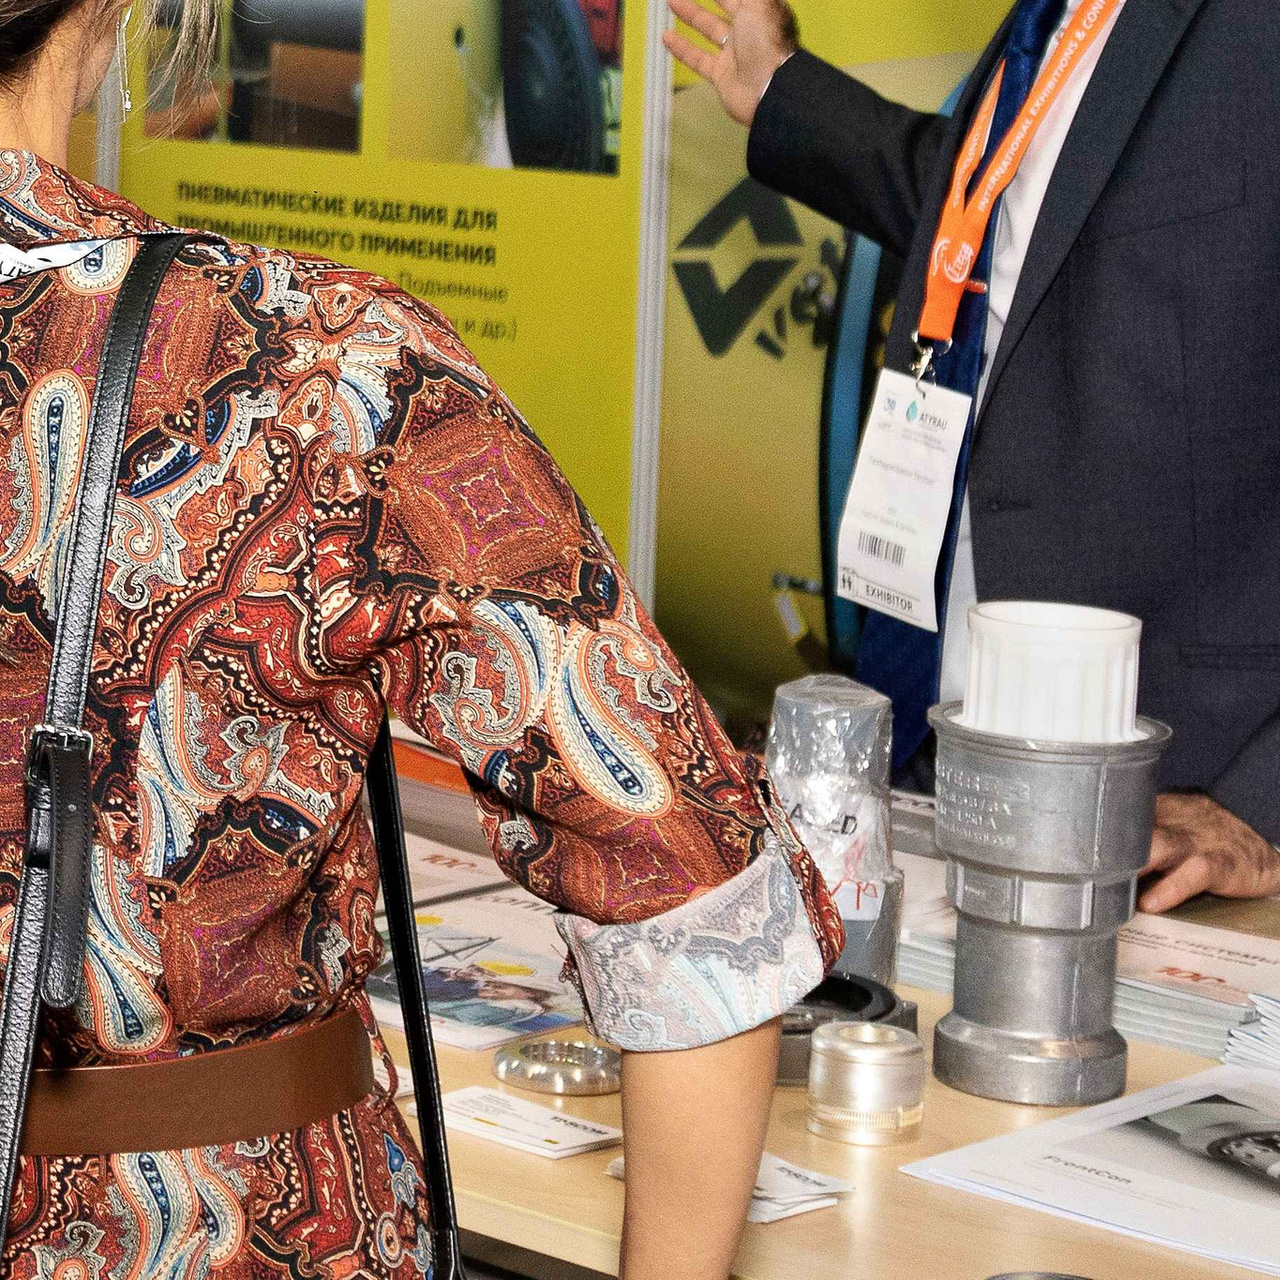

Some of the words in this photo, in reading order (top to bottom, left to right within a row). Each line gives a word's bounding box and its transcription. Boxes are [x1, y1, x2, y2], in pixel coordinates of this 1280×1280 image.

[977, 115, 1034, 213] INTERNATIONAL
[1028, 40, 1079, 117] EXHIBITIONS
[453, 206, 498, 232] ДЛЯ
[866, 584, 913, 611] EXHIBITOR
